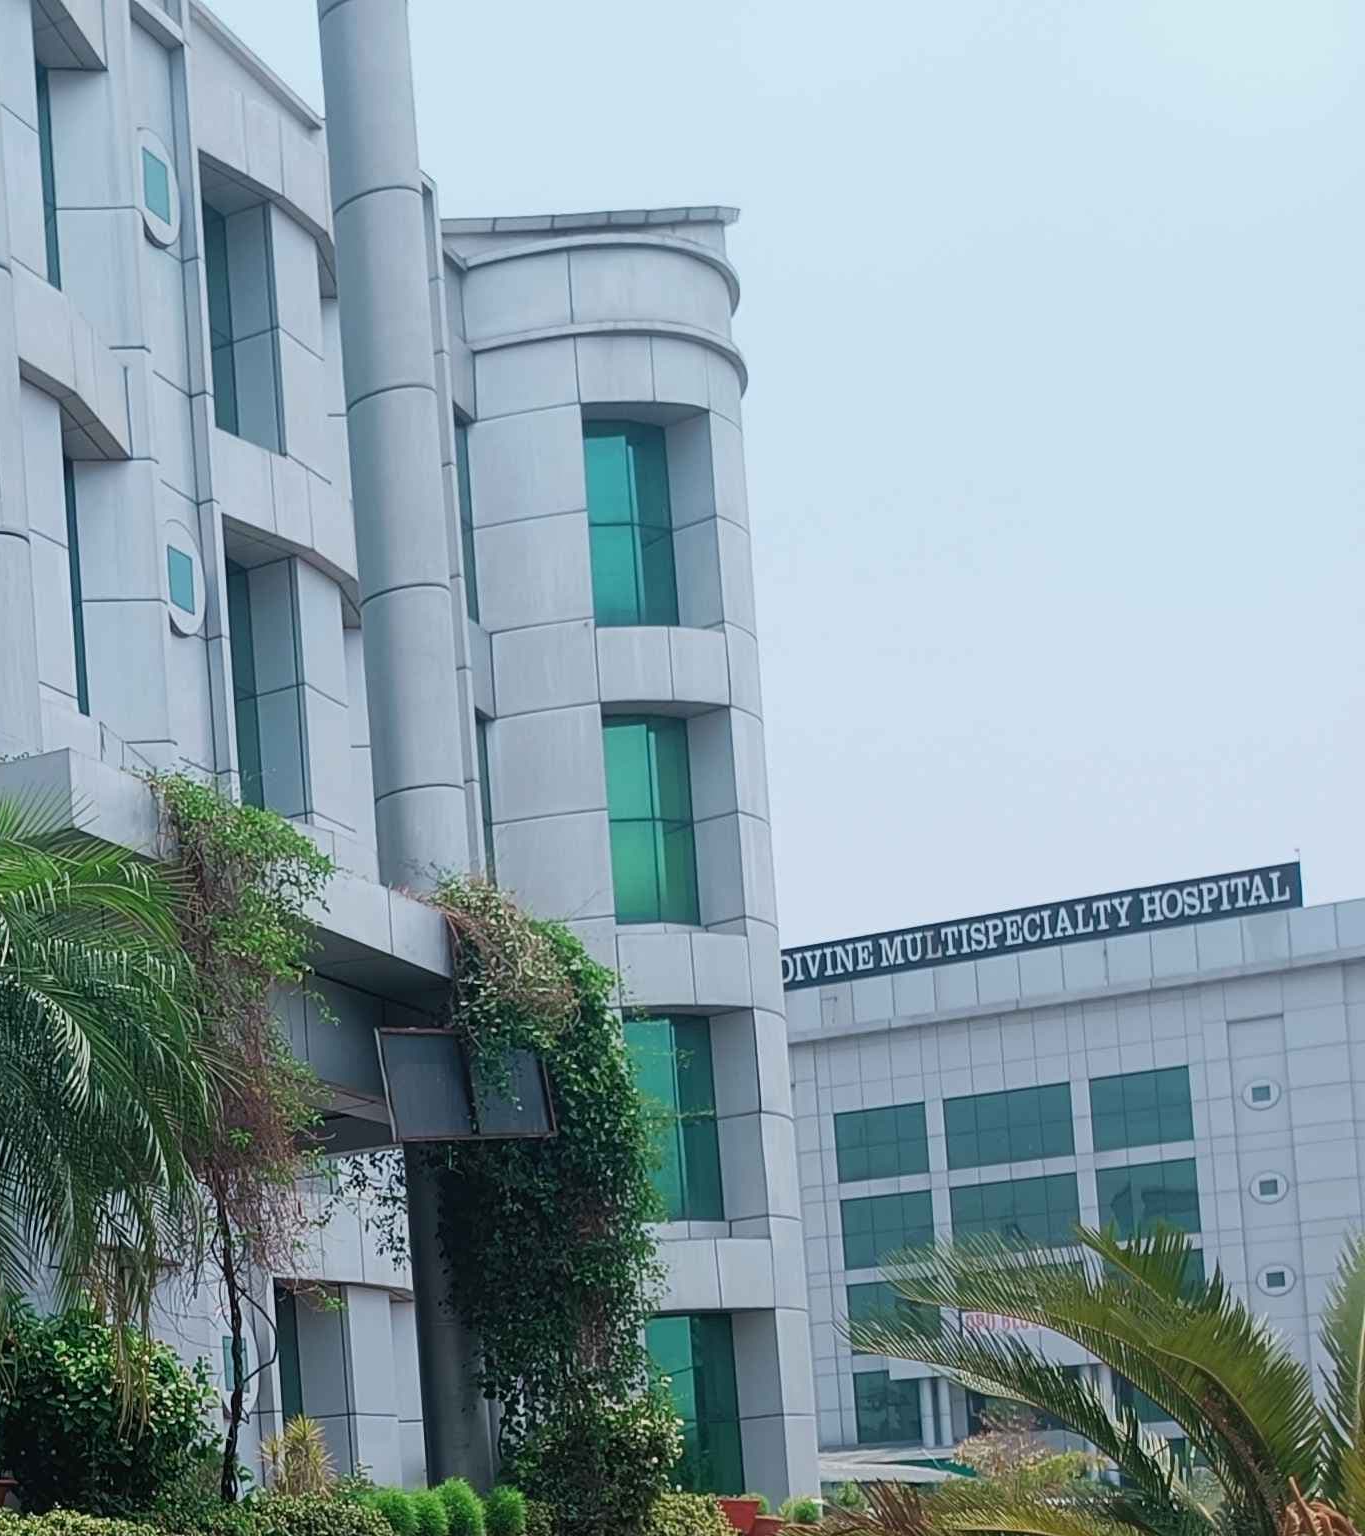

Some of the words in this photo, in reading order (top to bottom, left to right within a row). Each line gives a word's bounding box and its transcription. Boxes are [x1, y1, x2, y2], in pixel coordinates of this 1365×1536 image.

[781, 941, 874, 984] DIVINE
[879, 896, 1132, 967] MULTISPECIALTY
[1140, 871, 1290, 923] HOSPITAL
